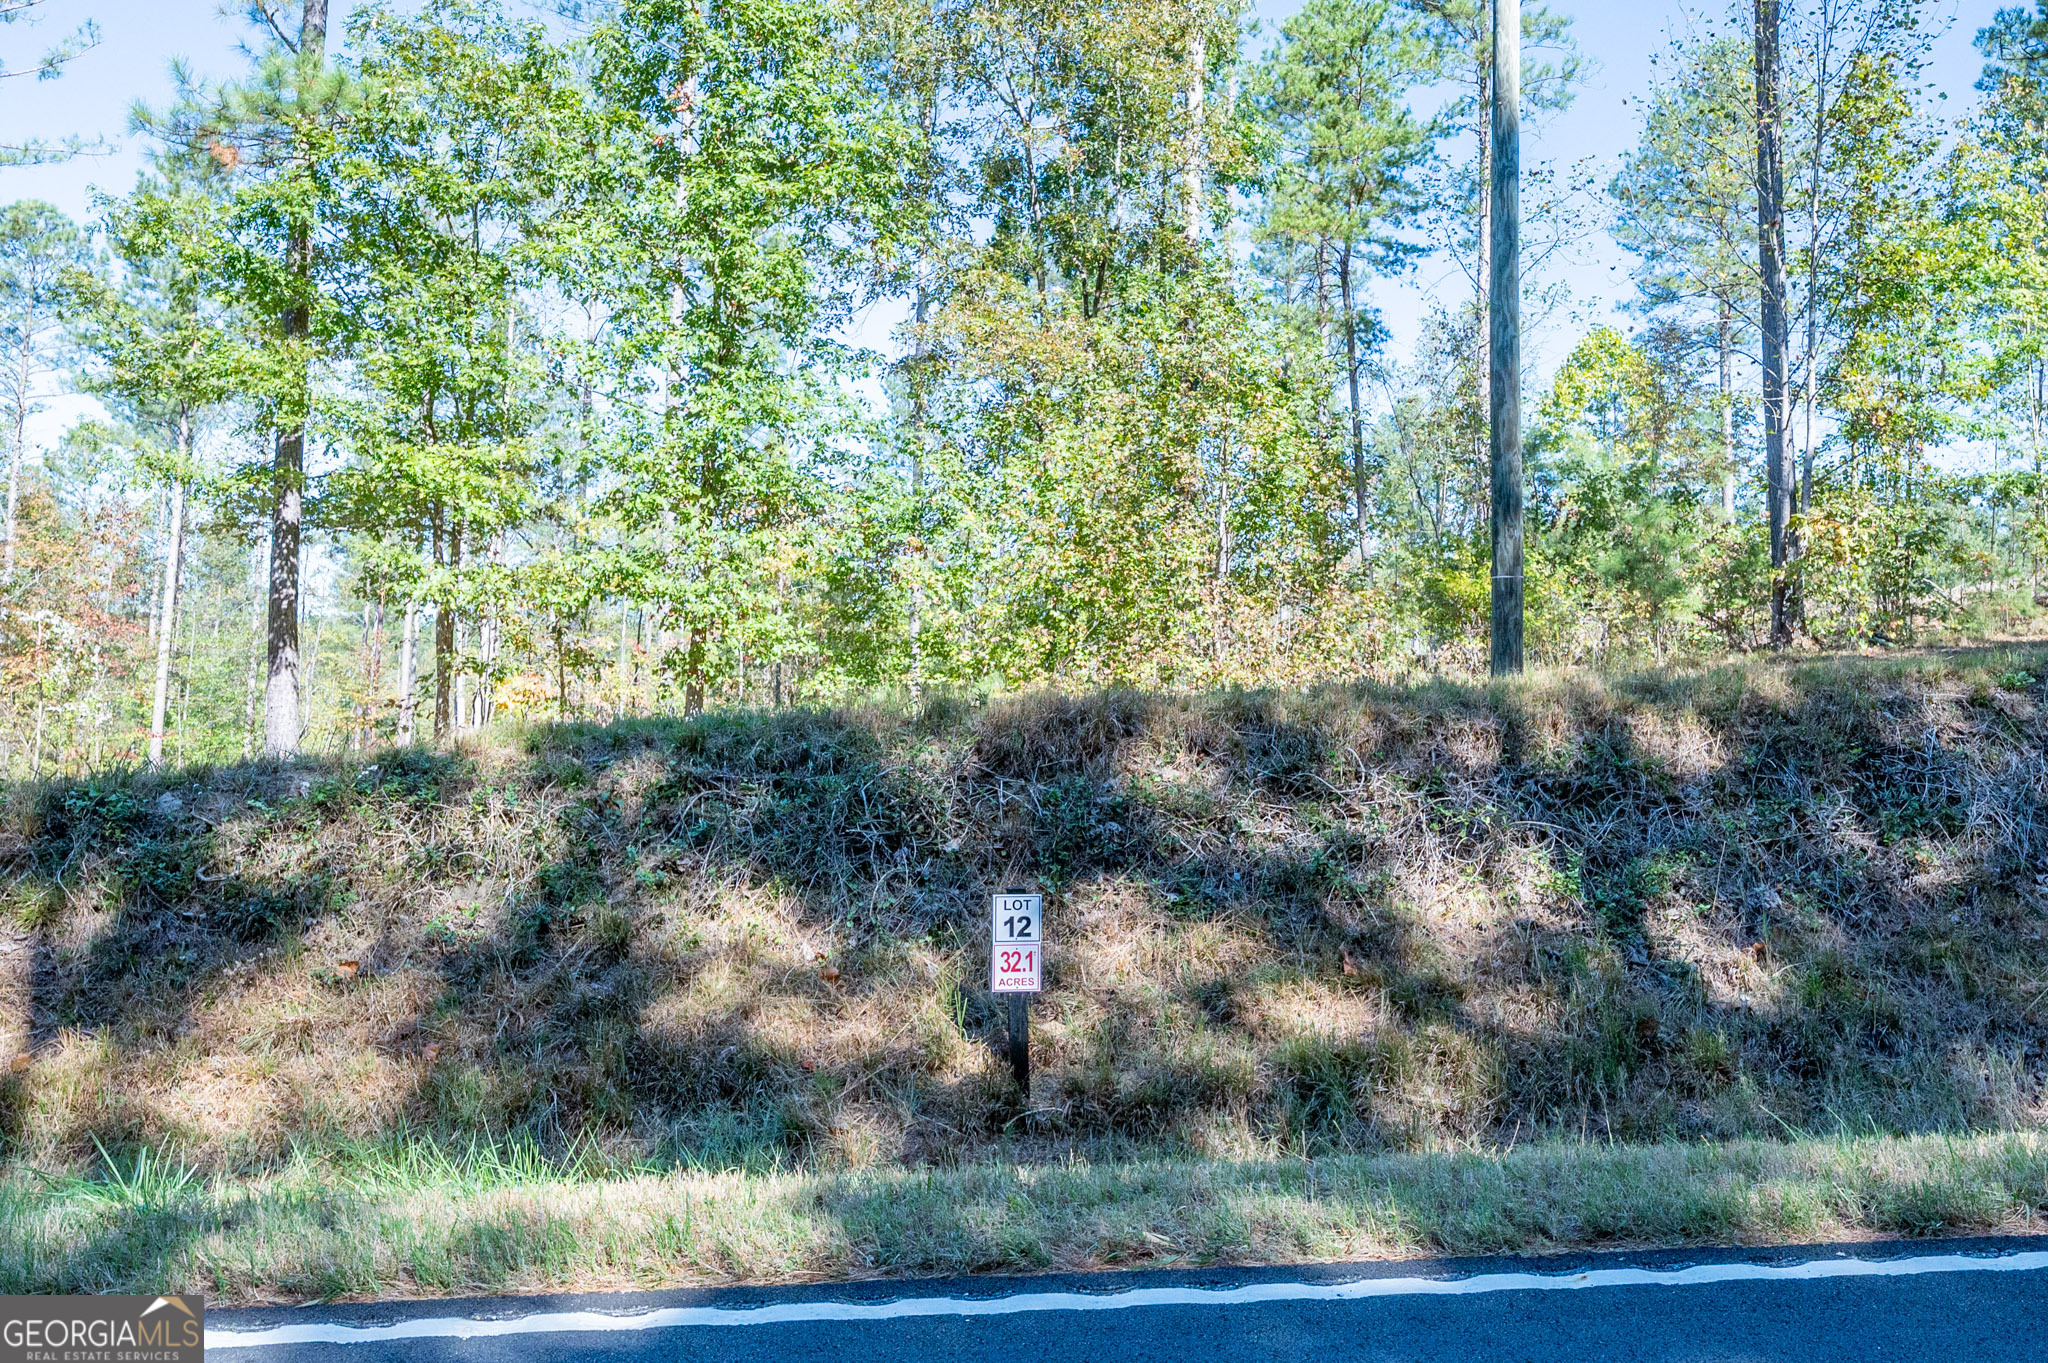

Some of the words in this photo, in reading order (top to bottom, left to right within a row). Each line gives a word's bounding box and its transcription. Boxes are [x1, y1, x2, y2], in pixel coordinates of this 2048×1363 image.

[1004, 899, 1032, 911] LOT
[1003, 915, 1032, 938] 12
[1000, 950, 1033, 973] 32.1
[998, 977, 1035, 987] ACRES
